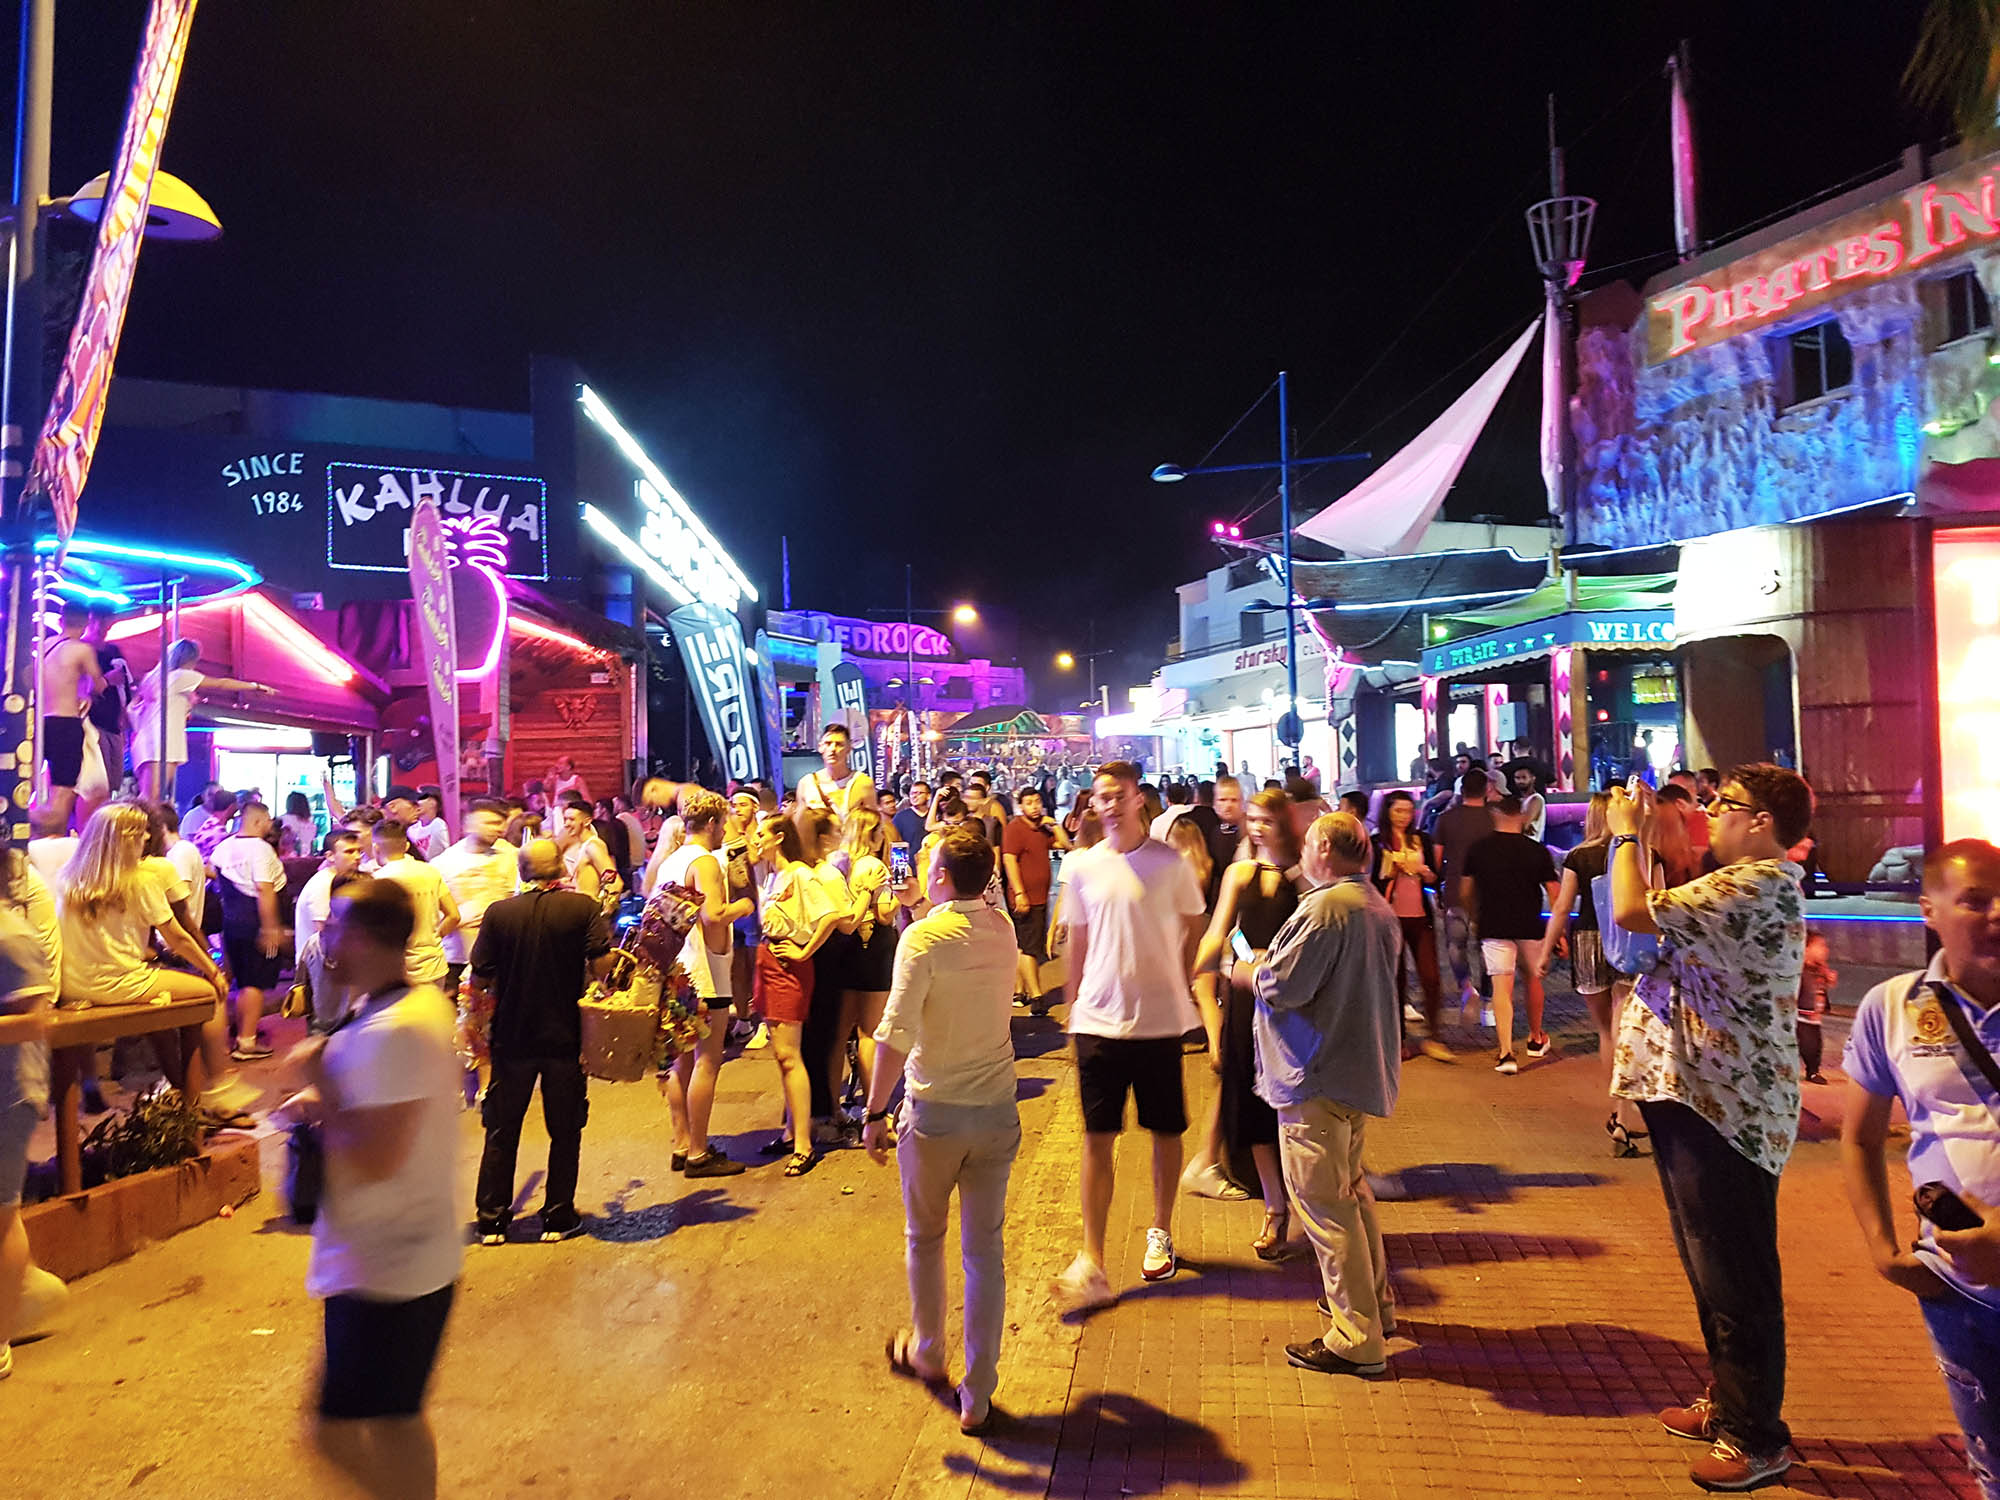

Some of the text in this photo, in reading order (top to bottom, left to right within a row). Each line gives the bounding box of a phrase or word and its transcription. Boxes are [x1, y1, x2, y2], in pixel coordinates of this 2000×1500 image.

[1652, 163, 2000, 357] PIRATES IN
[222, 453, 304, 487] SINCE
[251, 491, 304, 515] 1984
[335, 472, 540, 541] KAHLUA
[811, 615, 951, 656] BEDROCK
[1449, 640, 1499, 665] PIRATE
